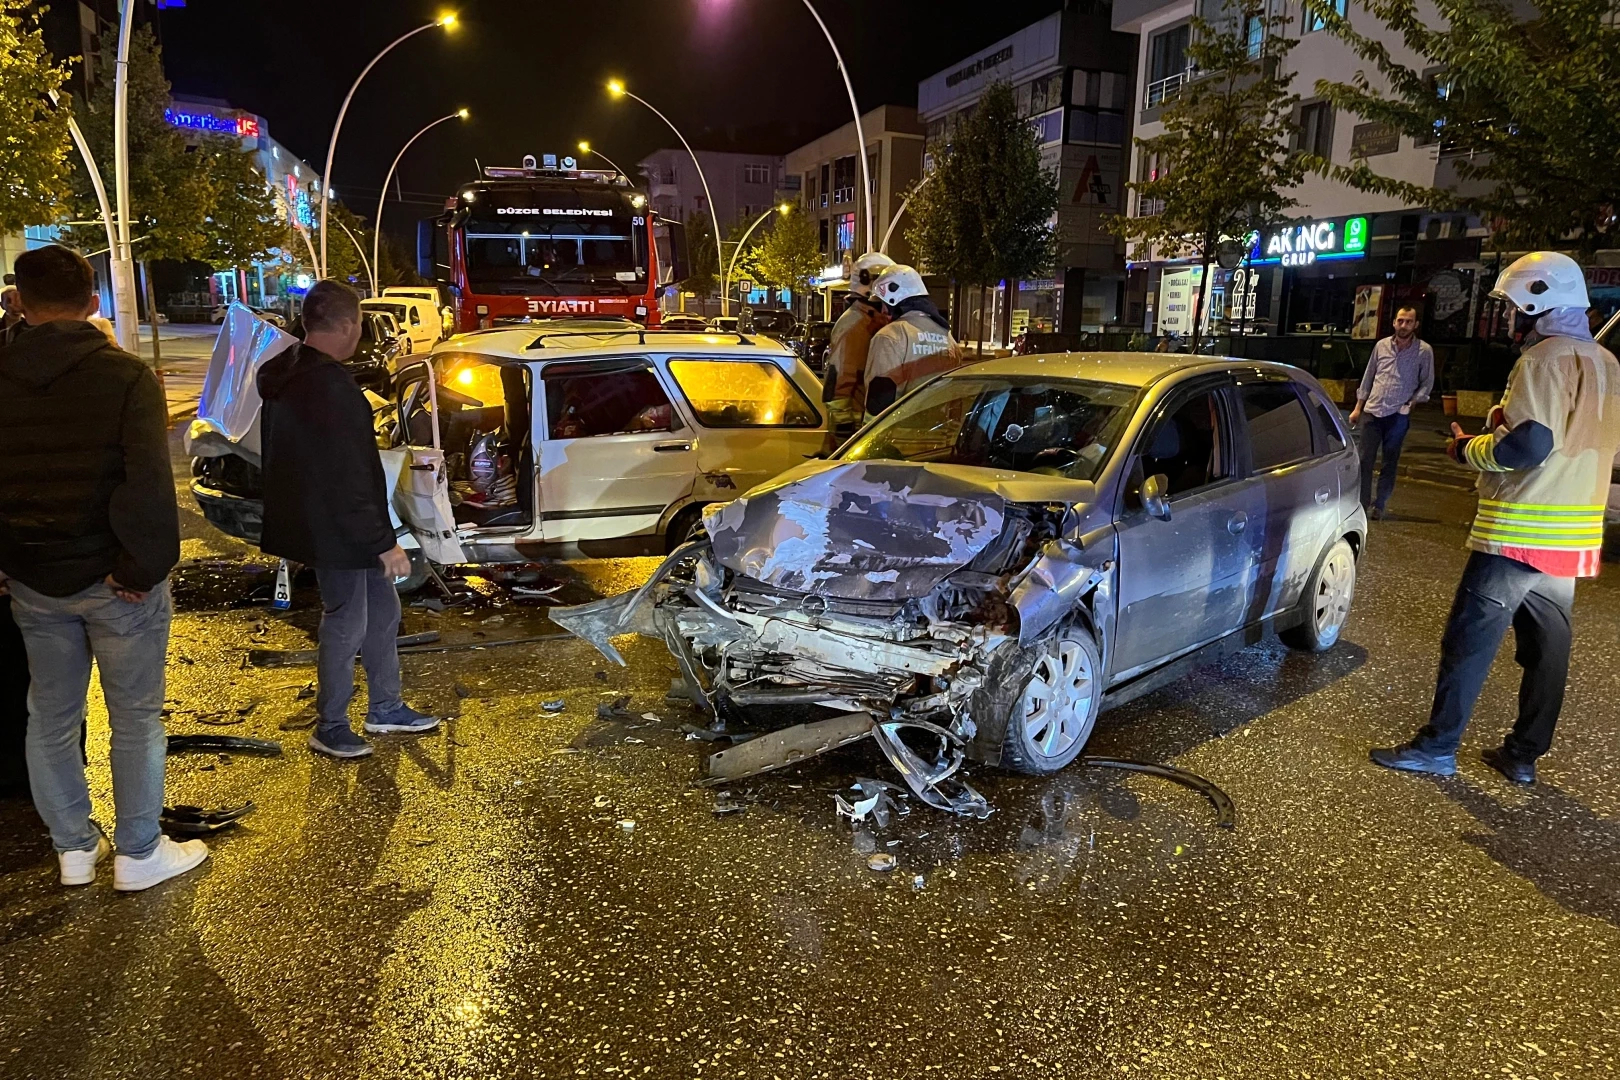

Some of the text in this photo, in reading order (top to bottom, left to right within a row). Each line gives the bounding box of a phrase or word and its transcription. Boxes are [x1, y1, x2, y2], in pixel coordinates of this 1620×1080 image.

[496, 207, 613, 217] DÜZCE BELEDİYESİ
[632, 216, 645, 226] 50
[1281, 251, 1316, 267] GRUP
[742, 282, 749, 291] D
[917, 331, 949, 345] DÜZCE
[277, 583, 288, 600] 81
